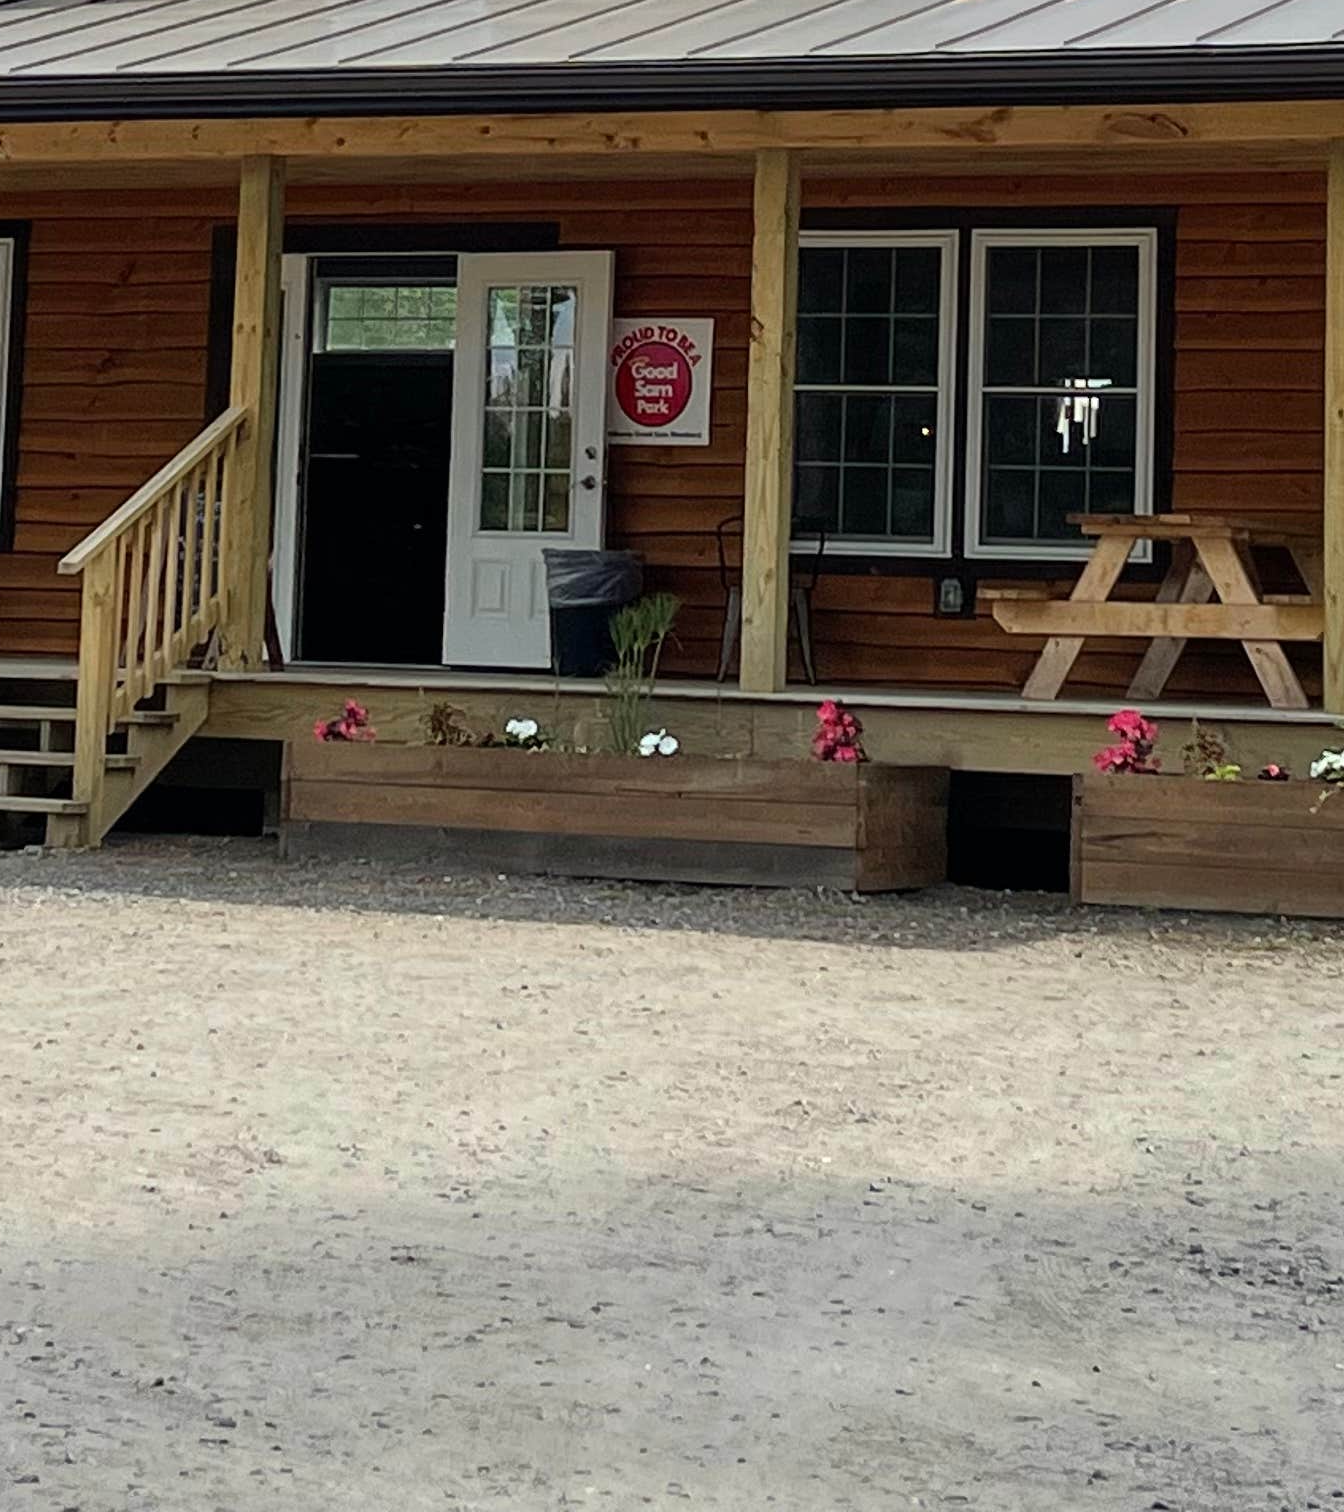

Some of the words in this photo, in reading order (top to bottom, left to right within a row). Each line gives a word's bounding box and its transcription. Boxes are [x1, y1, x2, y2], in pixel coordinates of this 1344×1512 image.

[611, 326, 655, 367] PROUD
[657, 325, 678, 342] TO
[677, 334, 696, 356] BE
[689, 354, 703, 368] A
[631, 360, 678, 380] Good
[634, 380, 674, 398] Sam
[636, 399, 670, 415] Park
